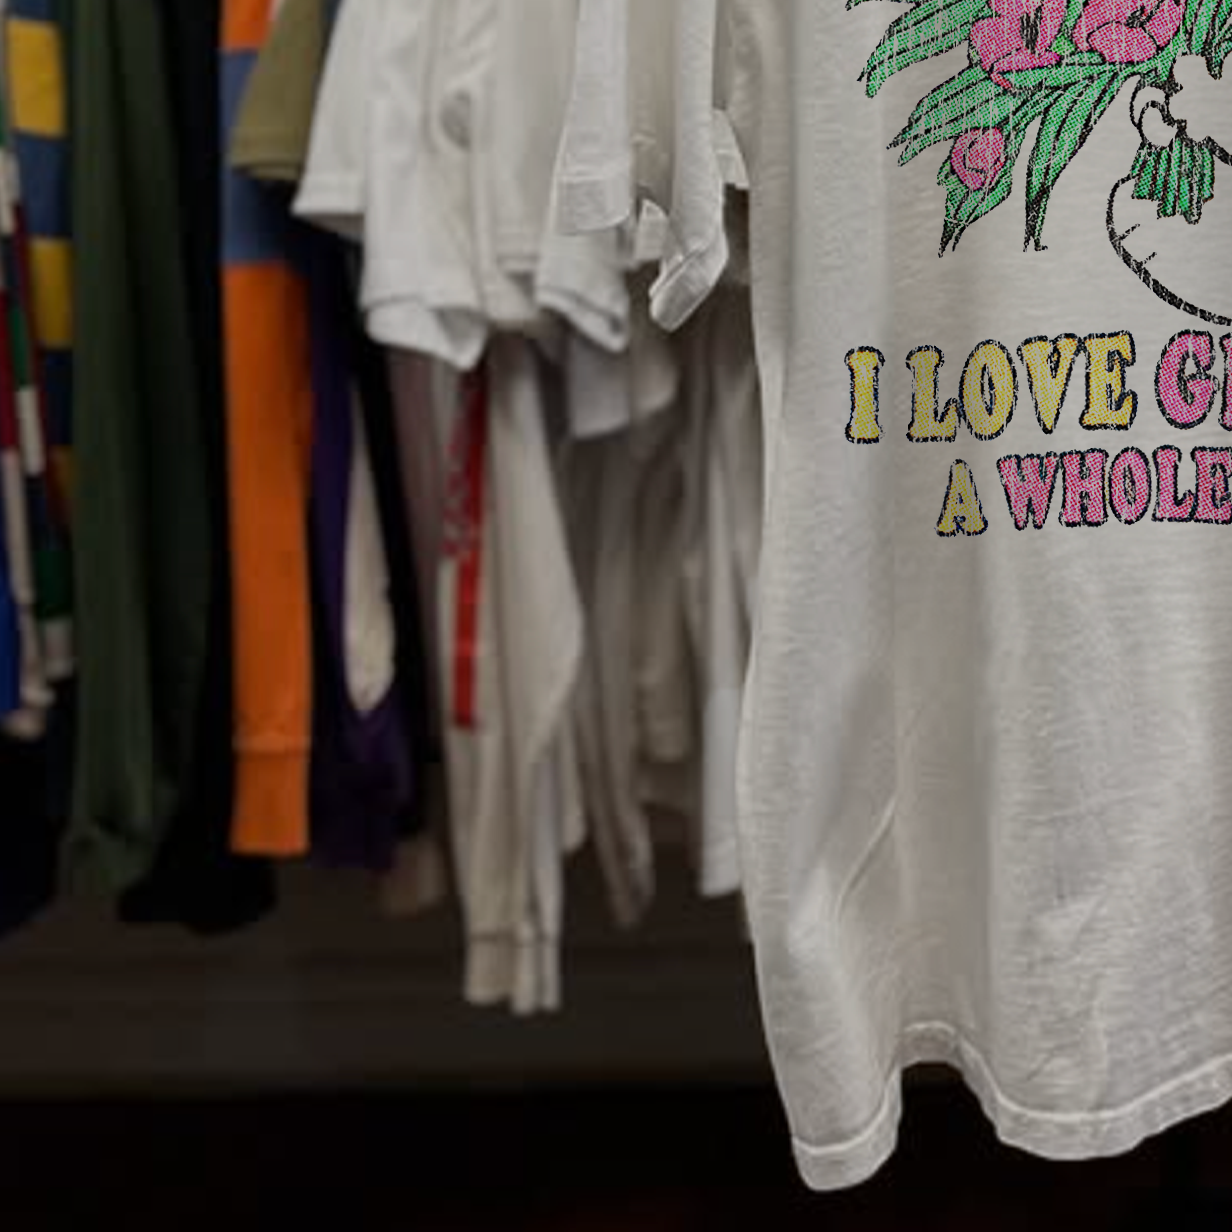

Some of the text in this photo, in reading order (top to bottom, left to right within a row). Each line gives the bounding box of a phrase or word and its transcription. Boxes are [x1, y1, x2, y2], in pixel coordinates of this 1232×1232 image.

[843, 345, 886, 445] I
[904, 330, 1138, 444] LOVE
[934, 458, 989, 537] A
